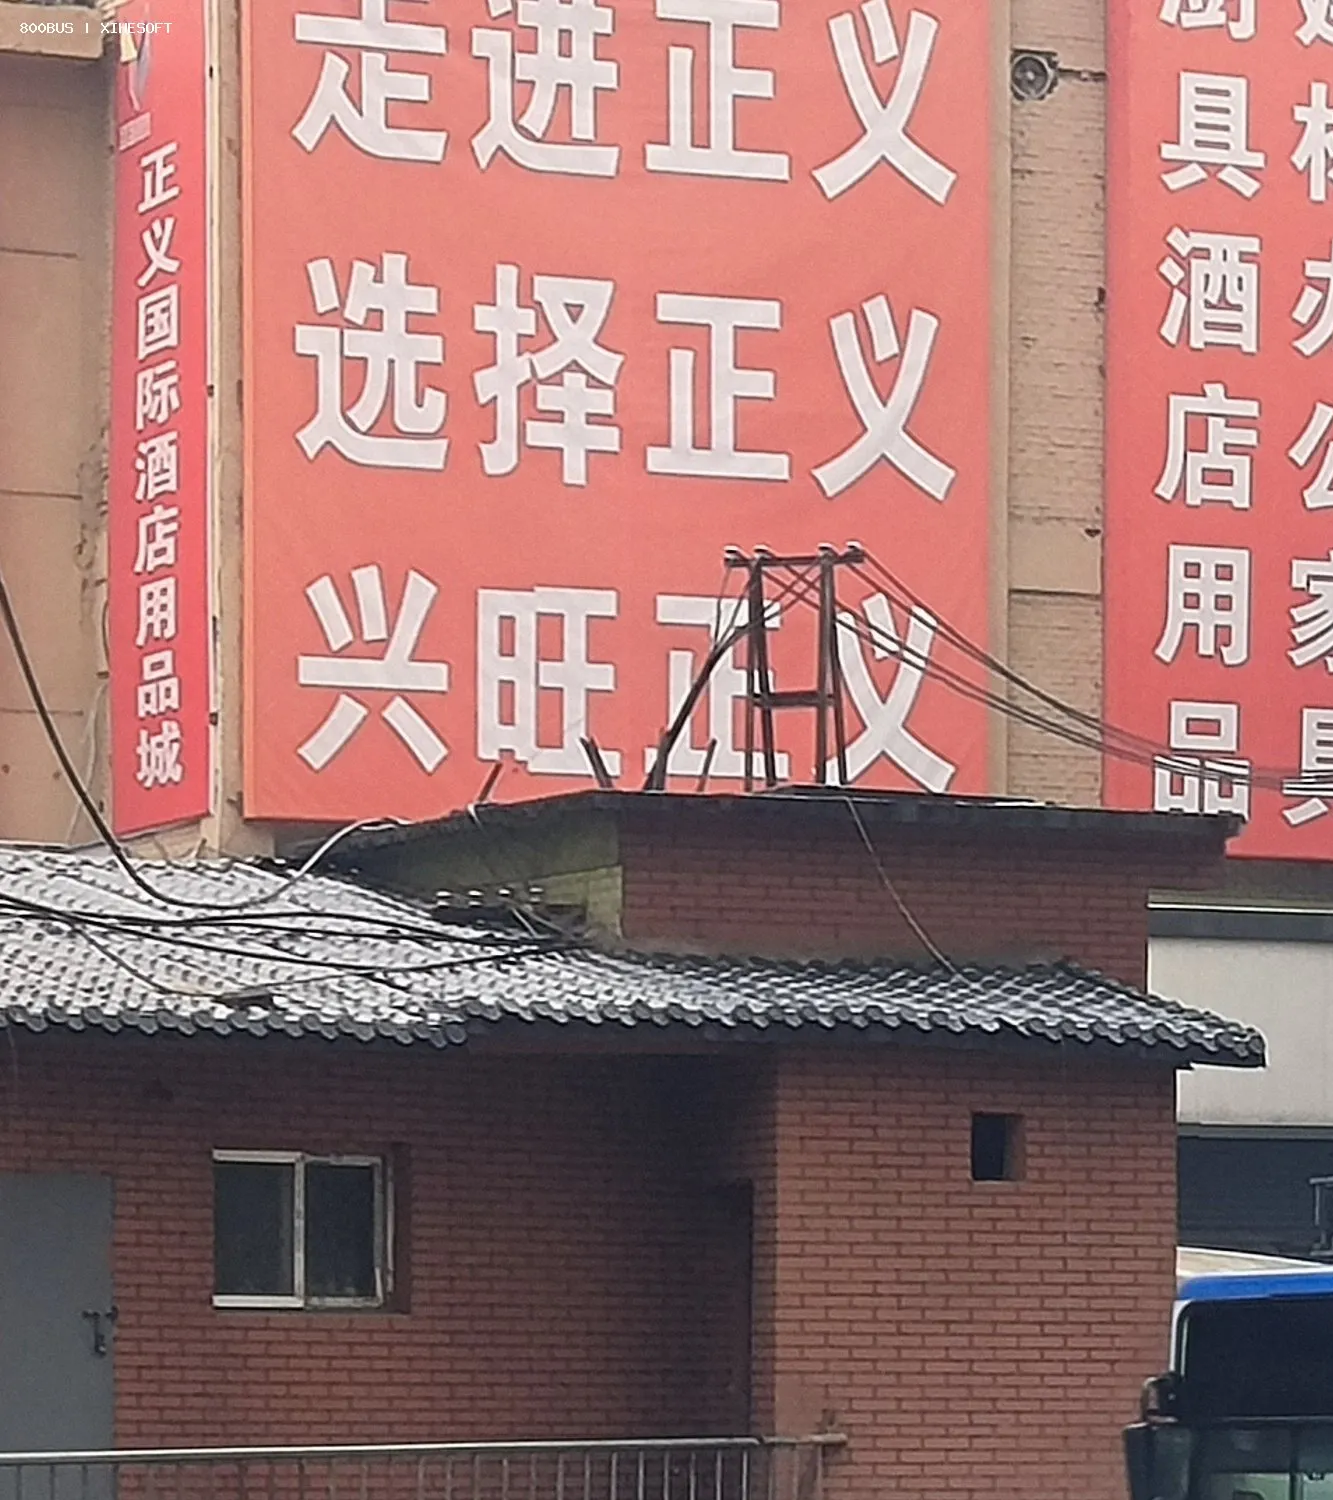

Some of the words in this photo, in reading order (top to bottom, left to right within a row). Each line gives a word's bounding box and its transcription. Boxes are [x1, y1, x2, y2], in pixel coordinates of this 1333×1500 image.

[291, 0, 958, 206] 走进正义
[135, 142, 185, 787] 正义国际酒店用品城
[292, 251, 958, 502] 选择正义
[296, 563, 958, 795] 兴旺正义
